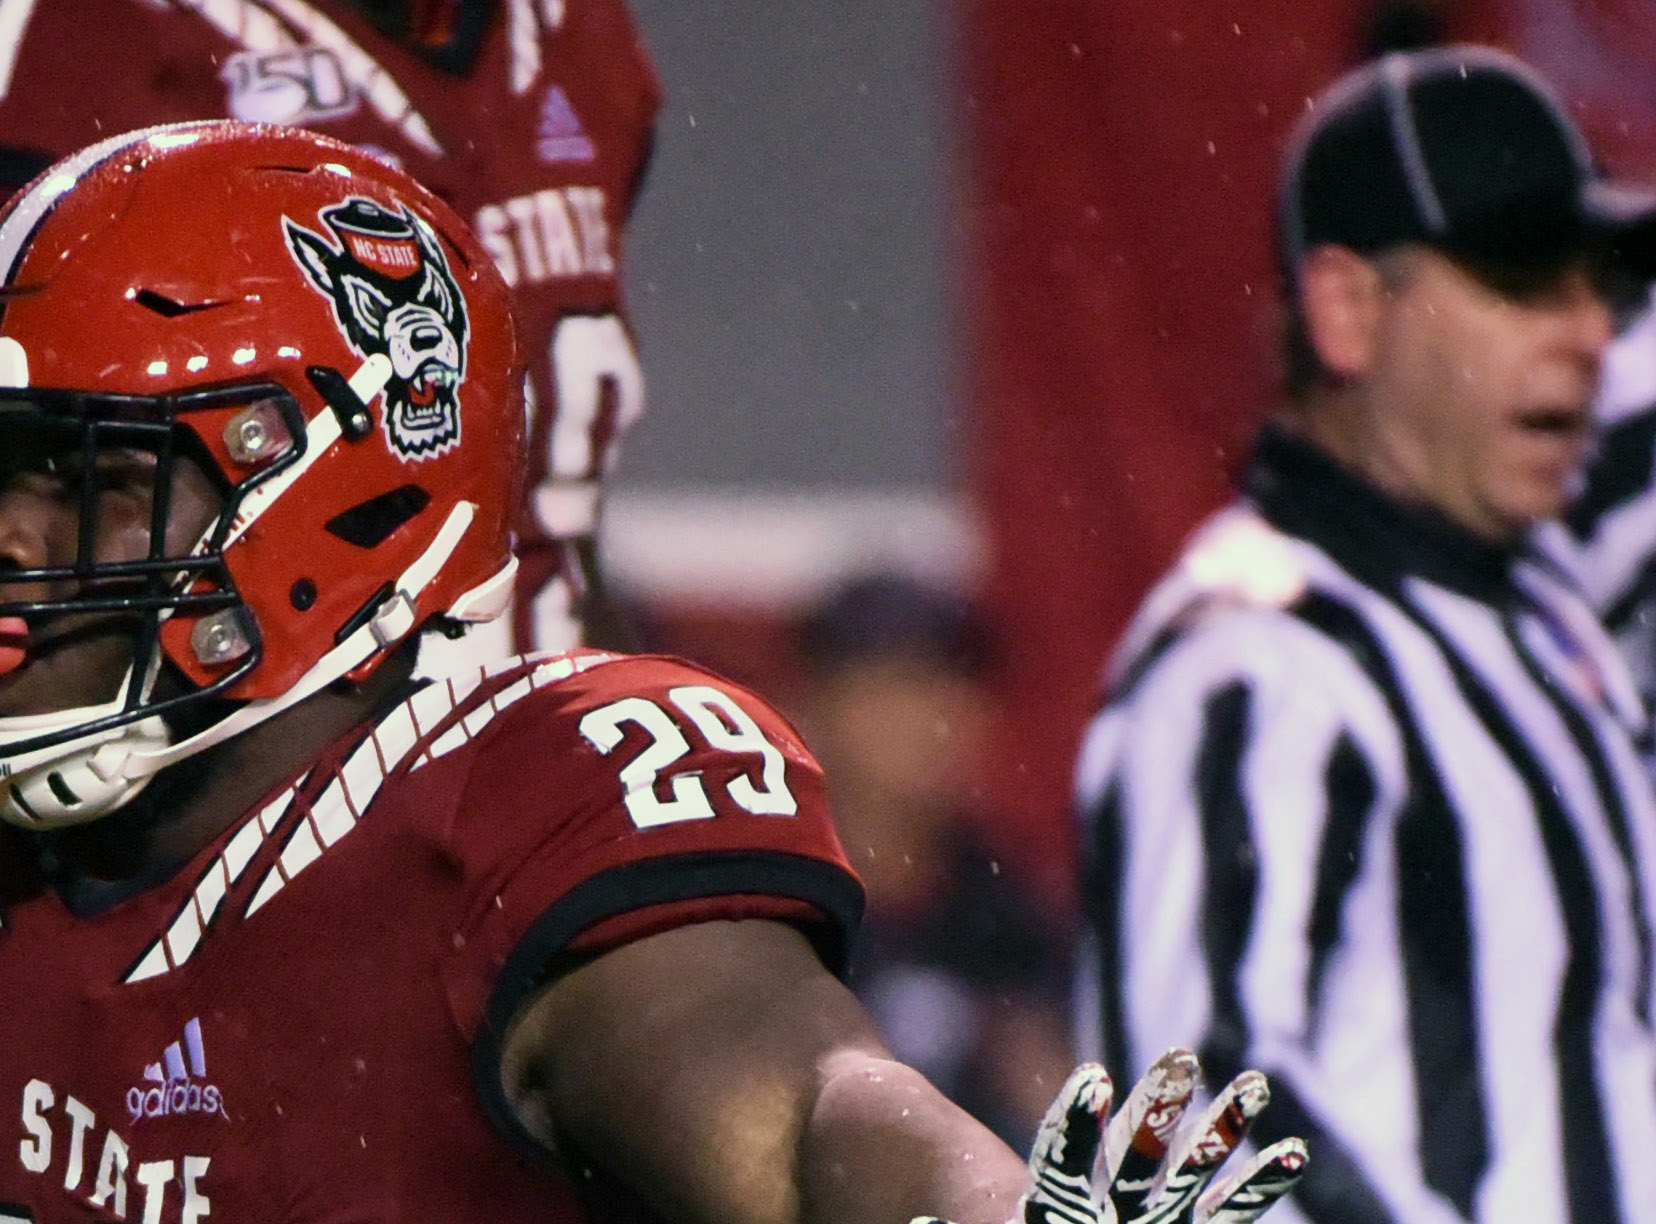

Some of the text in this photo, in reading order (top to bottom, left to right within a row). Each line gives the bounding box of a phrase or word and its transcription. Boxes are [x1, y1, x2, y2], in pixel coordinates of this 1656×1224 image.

[352, 237, 418, 267] NC STATE
[578, 686, 798, 832] 29
[126, 1075, 221, 1118] adidas
